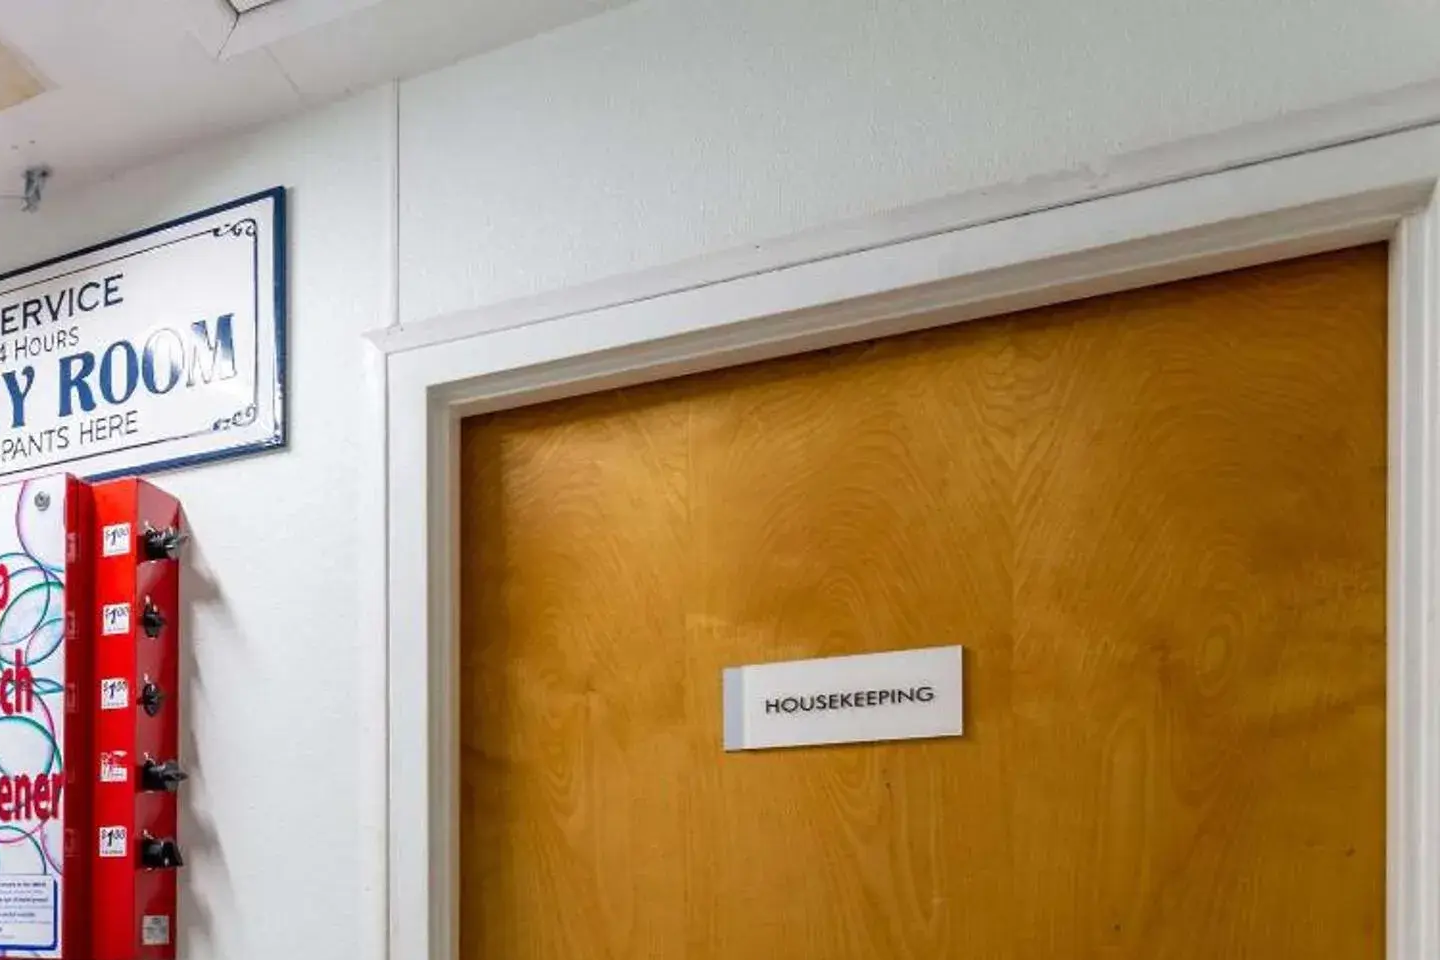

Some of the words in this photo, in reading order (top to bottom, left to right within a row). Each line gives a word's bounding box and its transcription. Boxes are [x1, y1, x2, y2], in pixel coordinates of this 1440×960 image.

[14, 326, 80, 363] HOURS
[58, 313, 238, 417] ROOM
[1, 430, 70, 462] PANTS
[79, 410, 139, 447] HERE
[765, 686, 935, 715] HOUSEKEEPING
